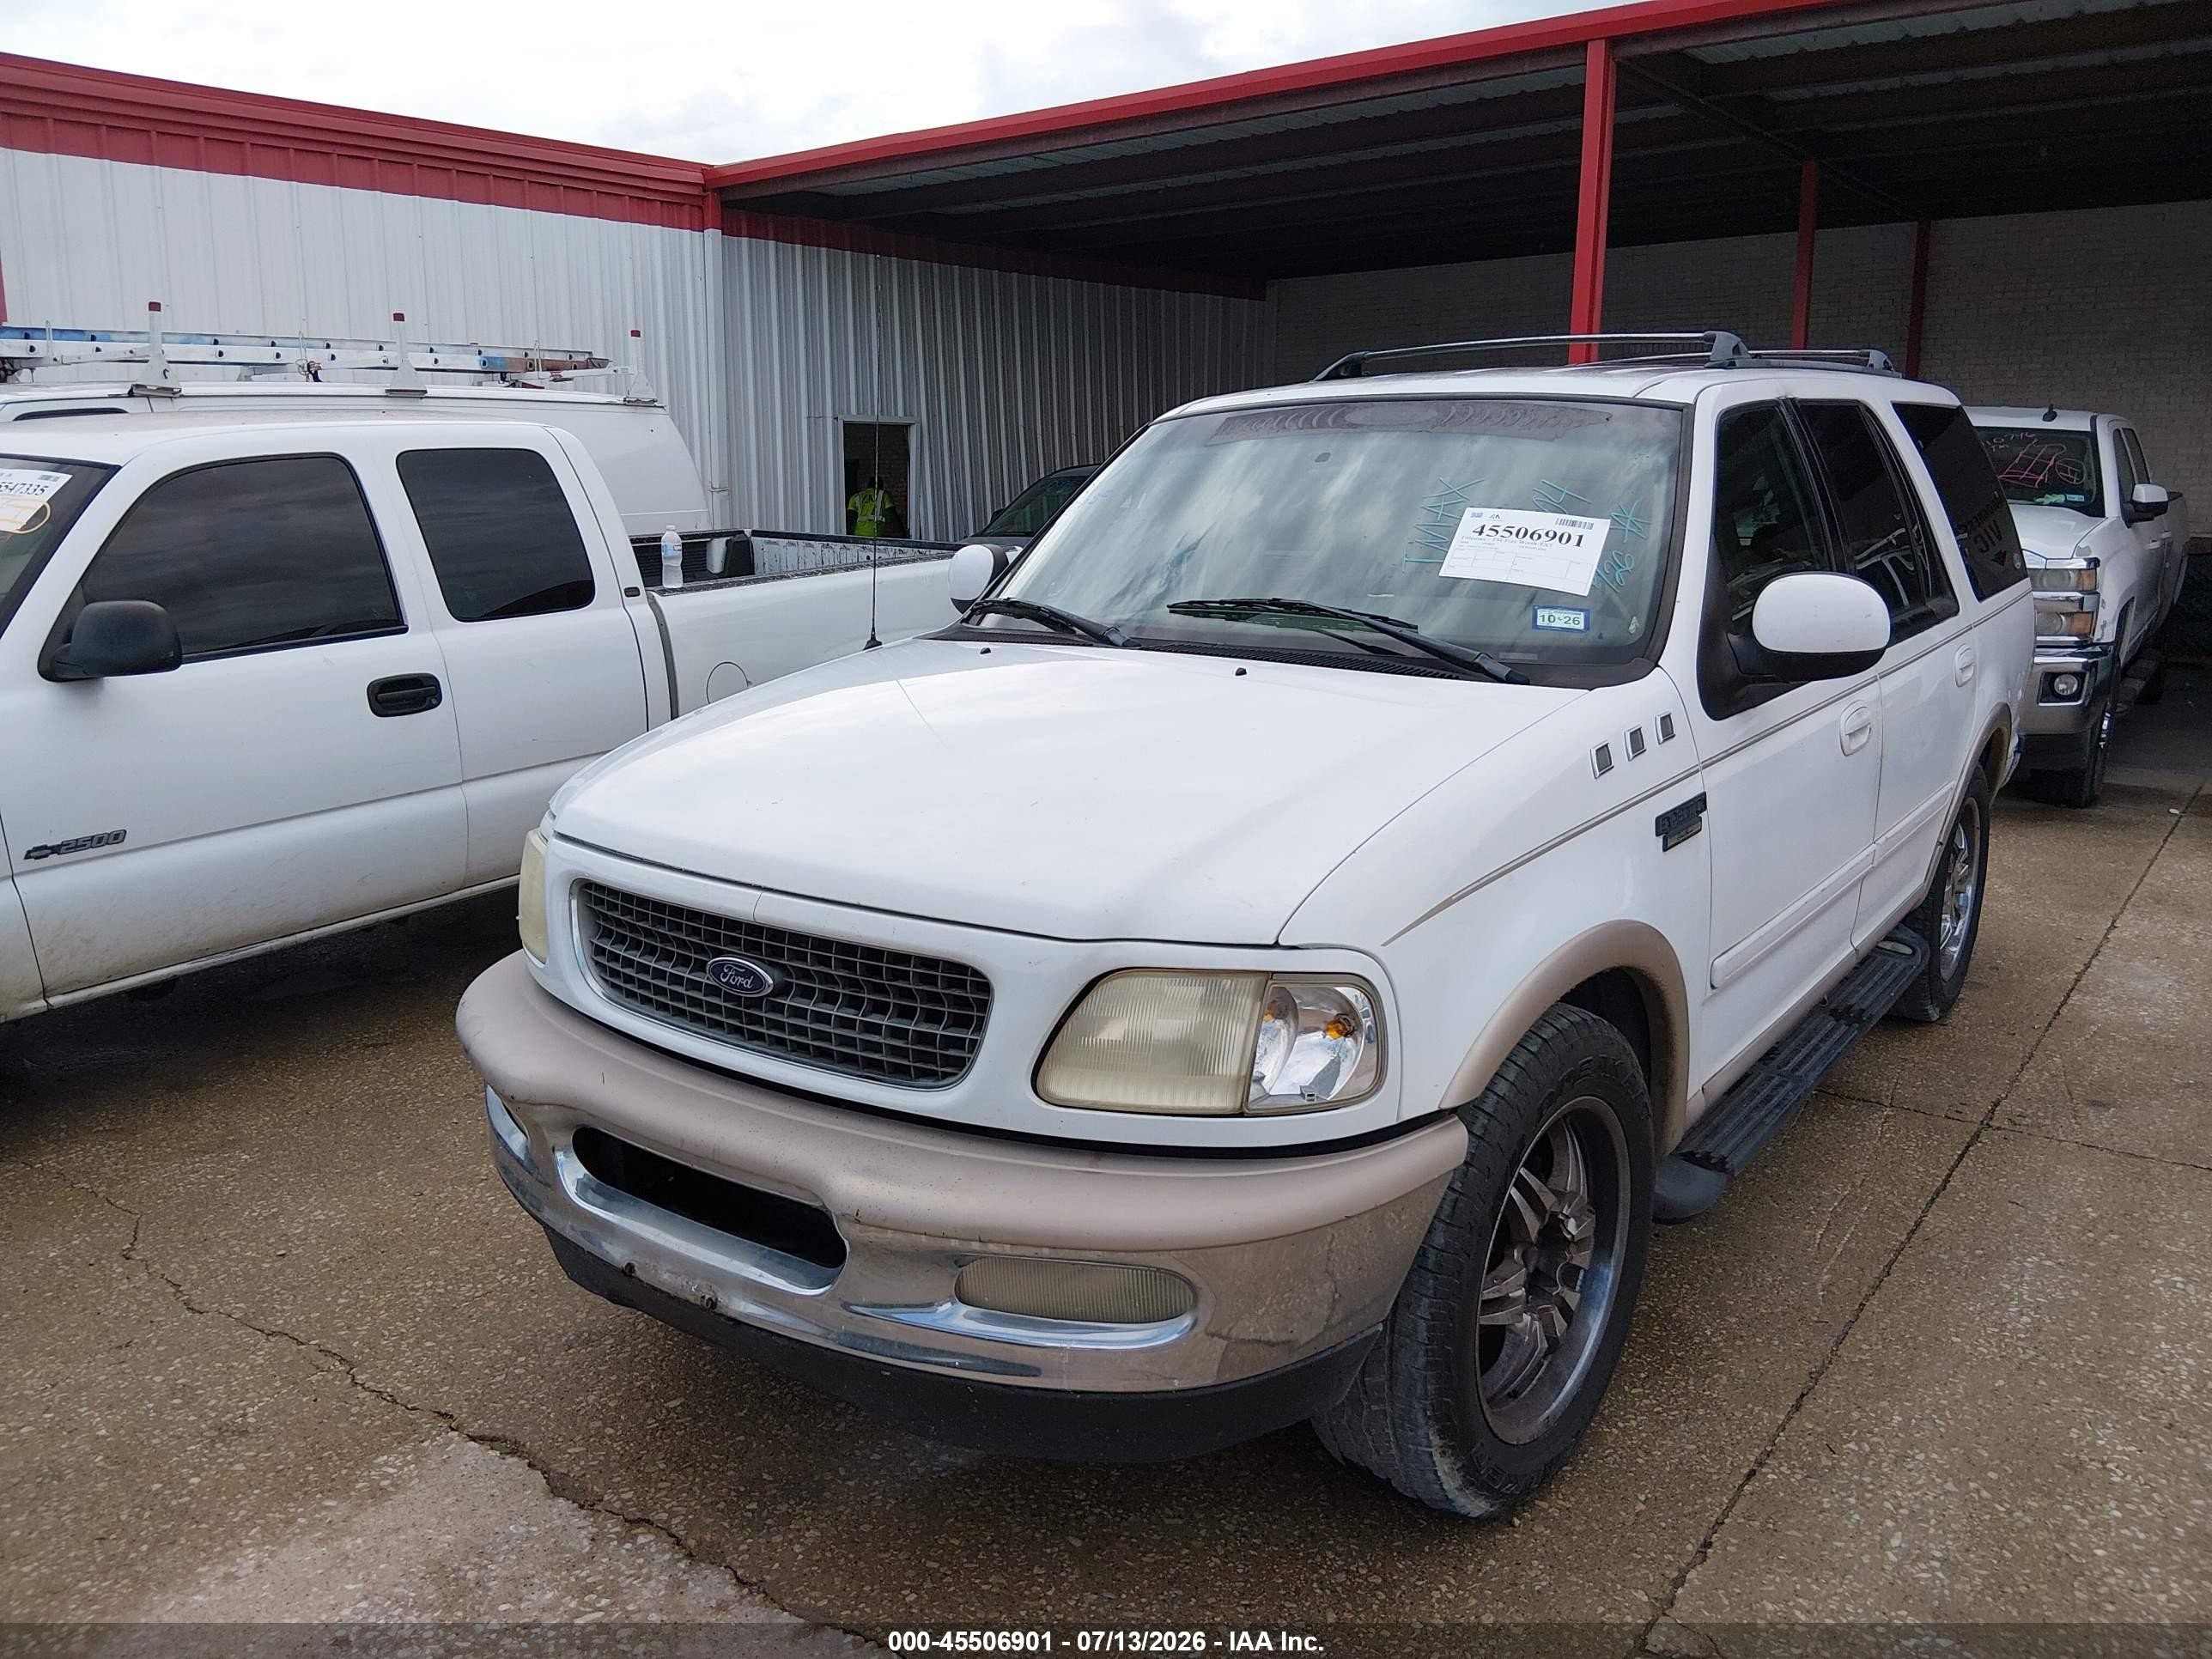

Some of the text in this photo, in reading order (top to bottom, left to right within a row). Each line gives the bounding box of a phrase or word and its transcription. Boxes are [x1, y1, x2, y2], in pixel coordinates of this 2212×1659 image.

[1472, 524, 1585, 548] 45506901
[57, 829, 127, 855] 2500
[720, 963, 755, 989] Ford
